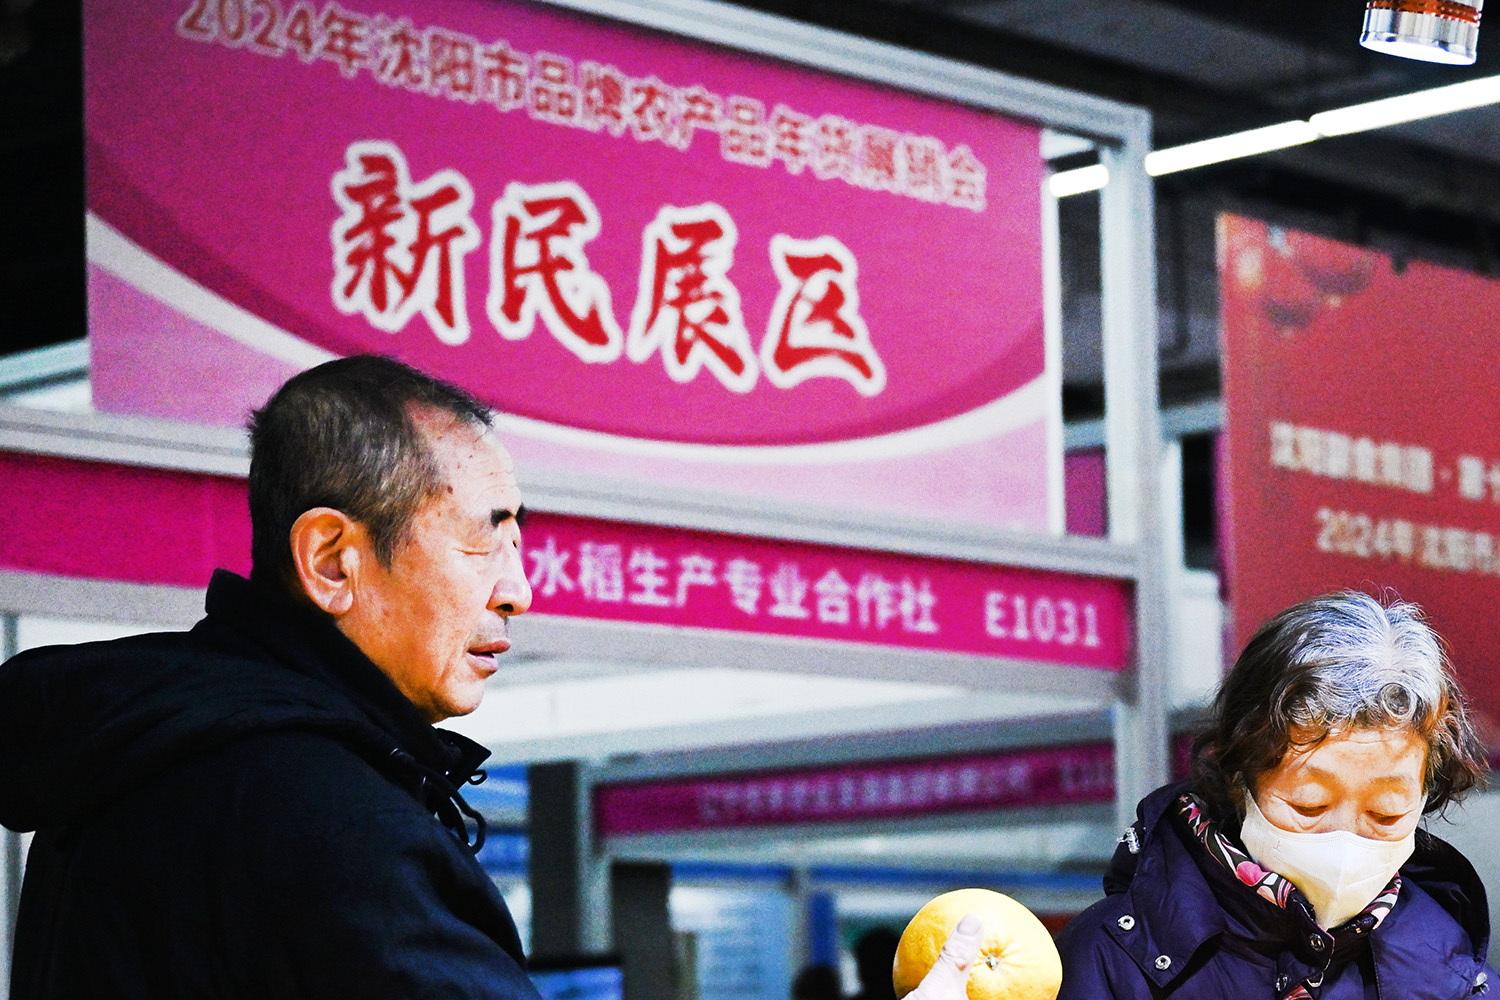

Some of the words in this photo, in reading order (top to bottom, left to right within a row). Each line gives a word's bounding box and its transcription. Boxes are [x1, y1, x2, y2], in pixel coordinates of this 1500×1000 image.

[330, 139, 887, 397] 新民展区
[527, 536, 939, 634] 水稻生产专业合作社
[983, 591, 1101, 648] E1031
